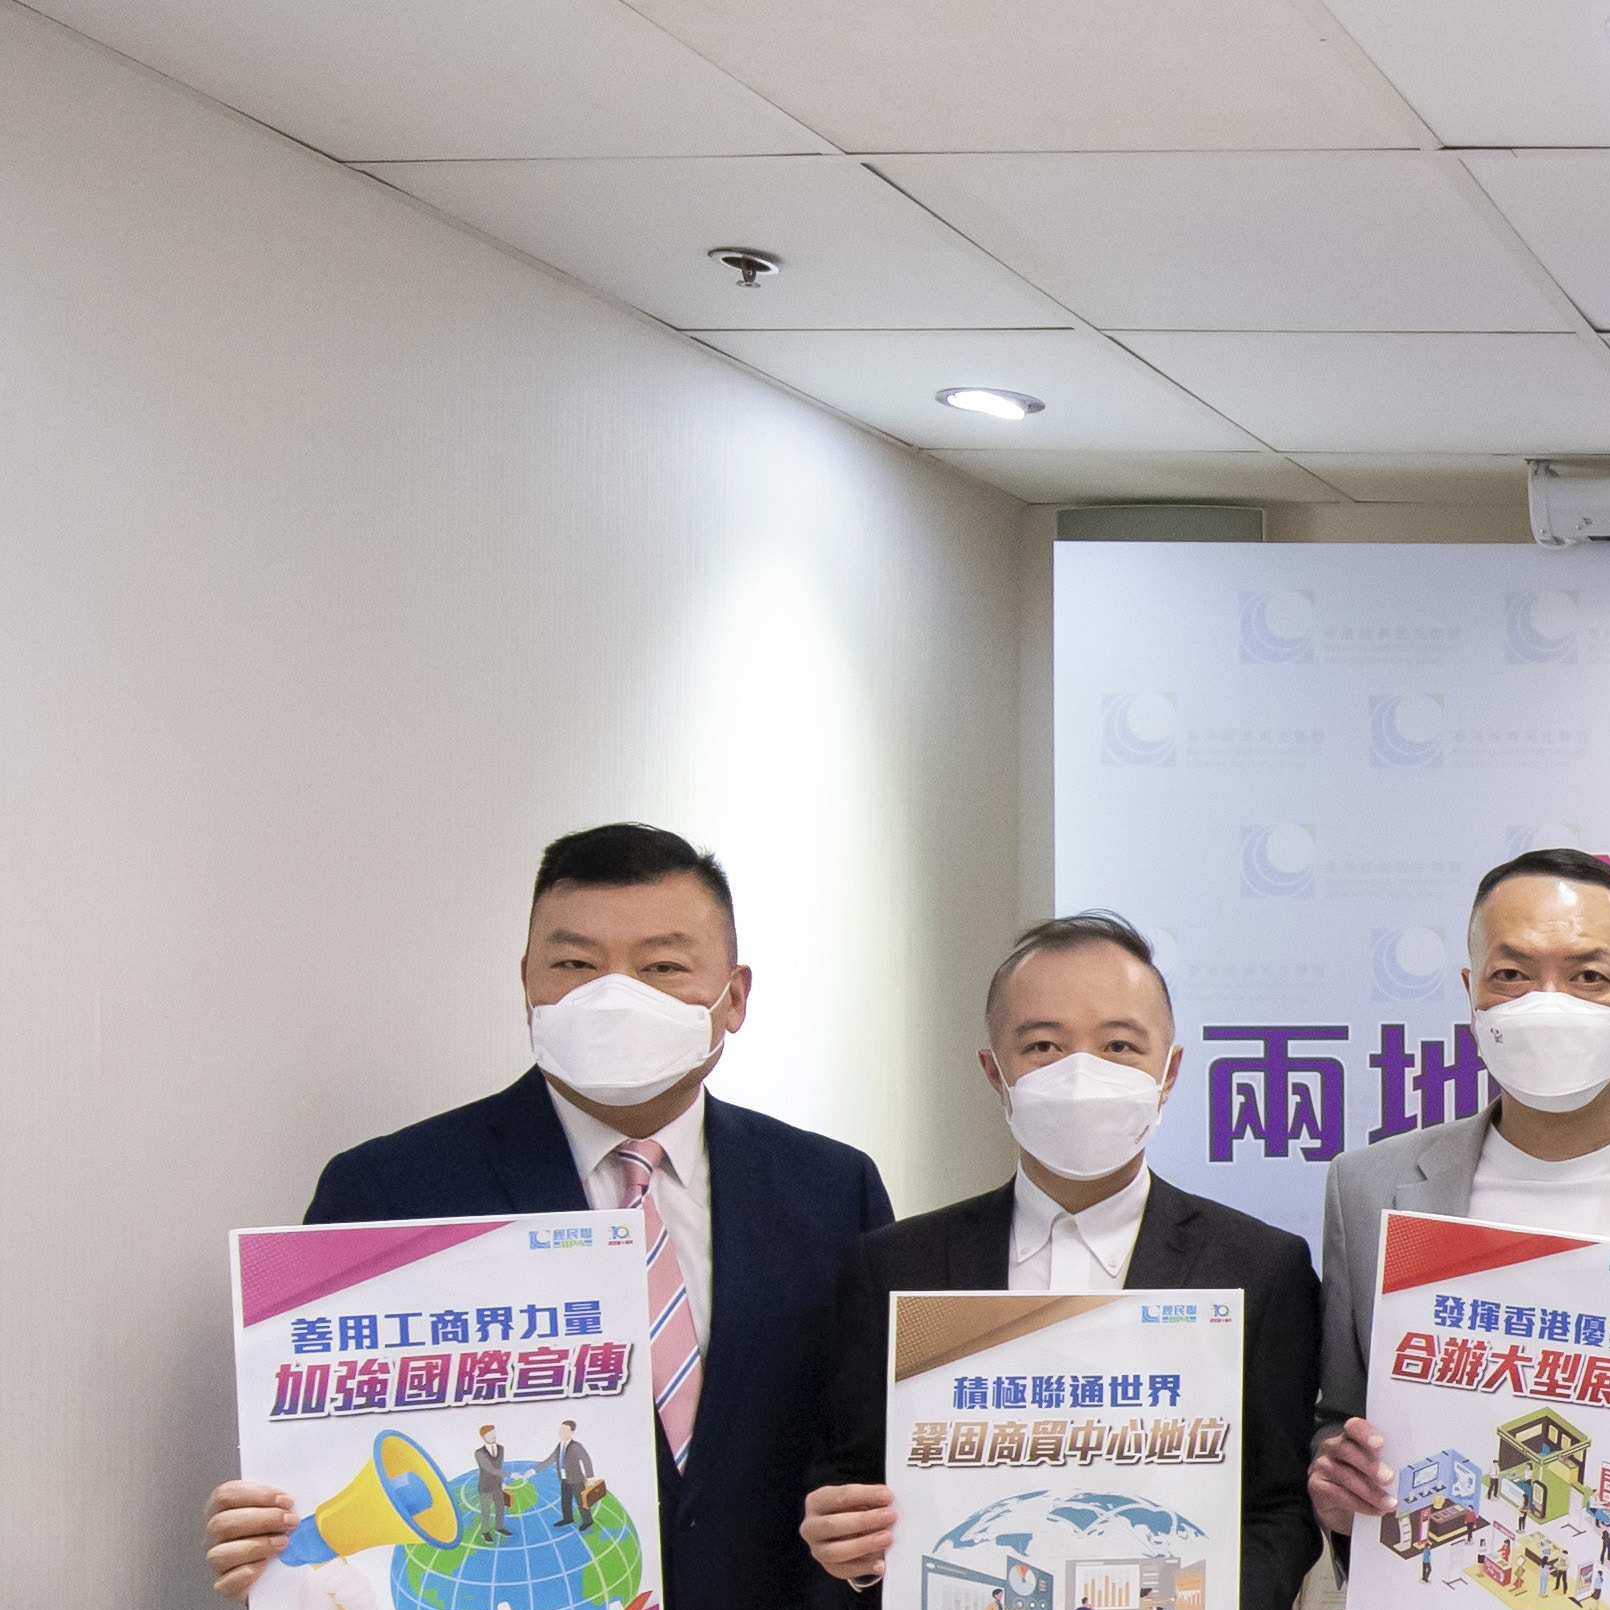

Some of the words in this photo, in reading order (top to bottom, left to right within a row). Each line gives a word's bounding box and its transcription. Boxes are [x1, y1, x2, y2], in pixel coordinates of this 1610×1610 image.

[290, 1300, 603, 1355] 善用工商界力量
[268, 1342, 632, 1421] 加強國際宣傳
[953, 1374, 1182, 1409] 積極聯通世界
[907, 1417, 1230, 1466] 鞏固商貿中心地位
